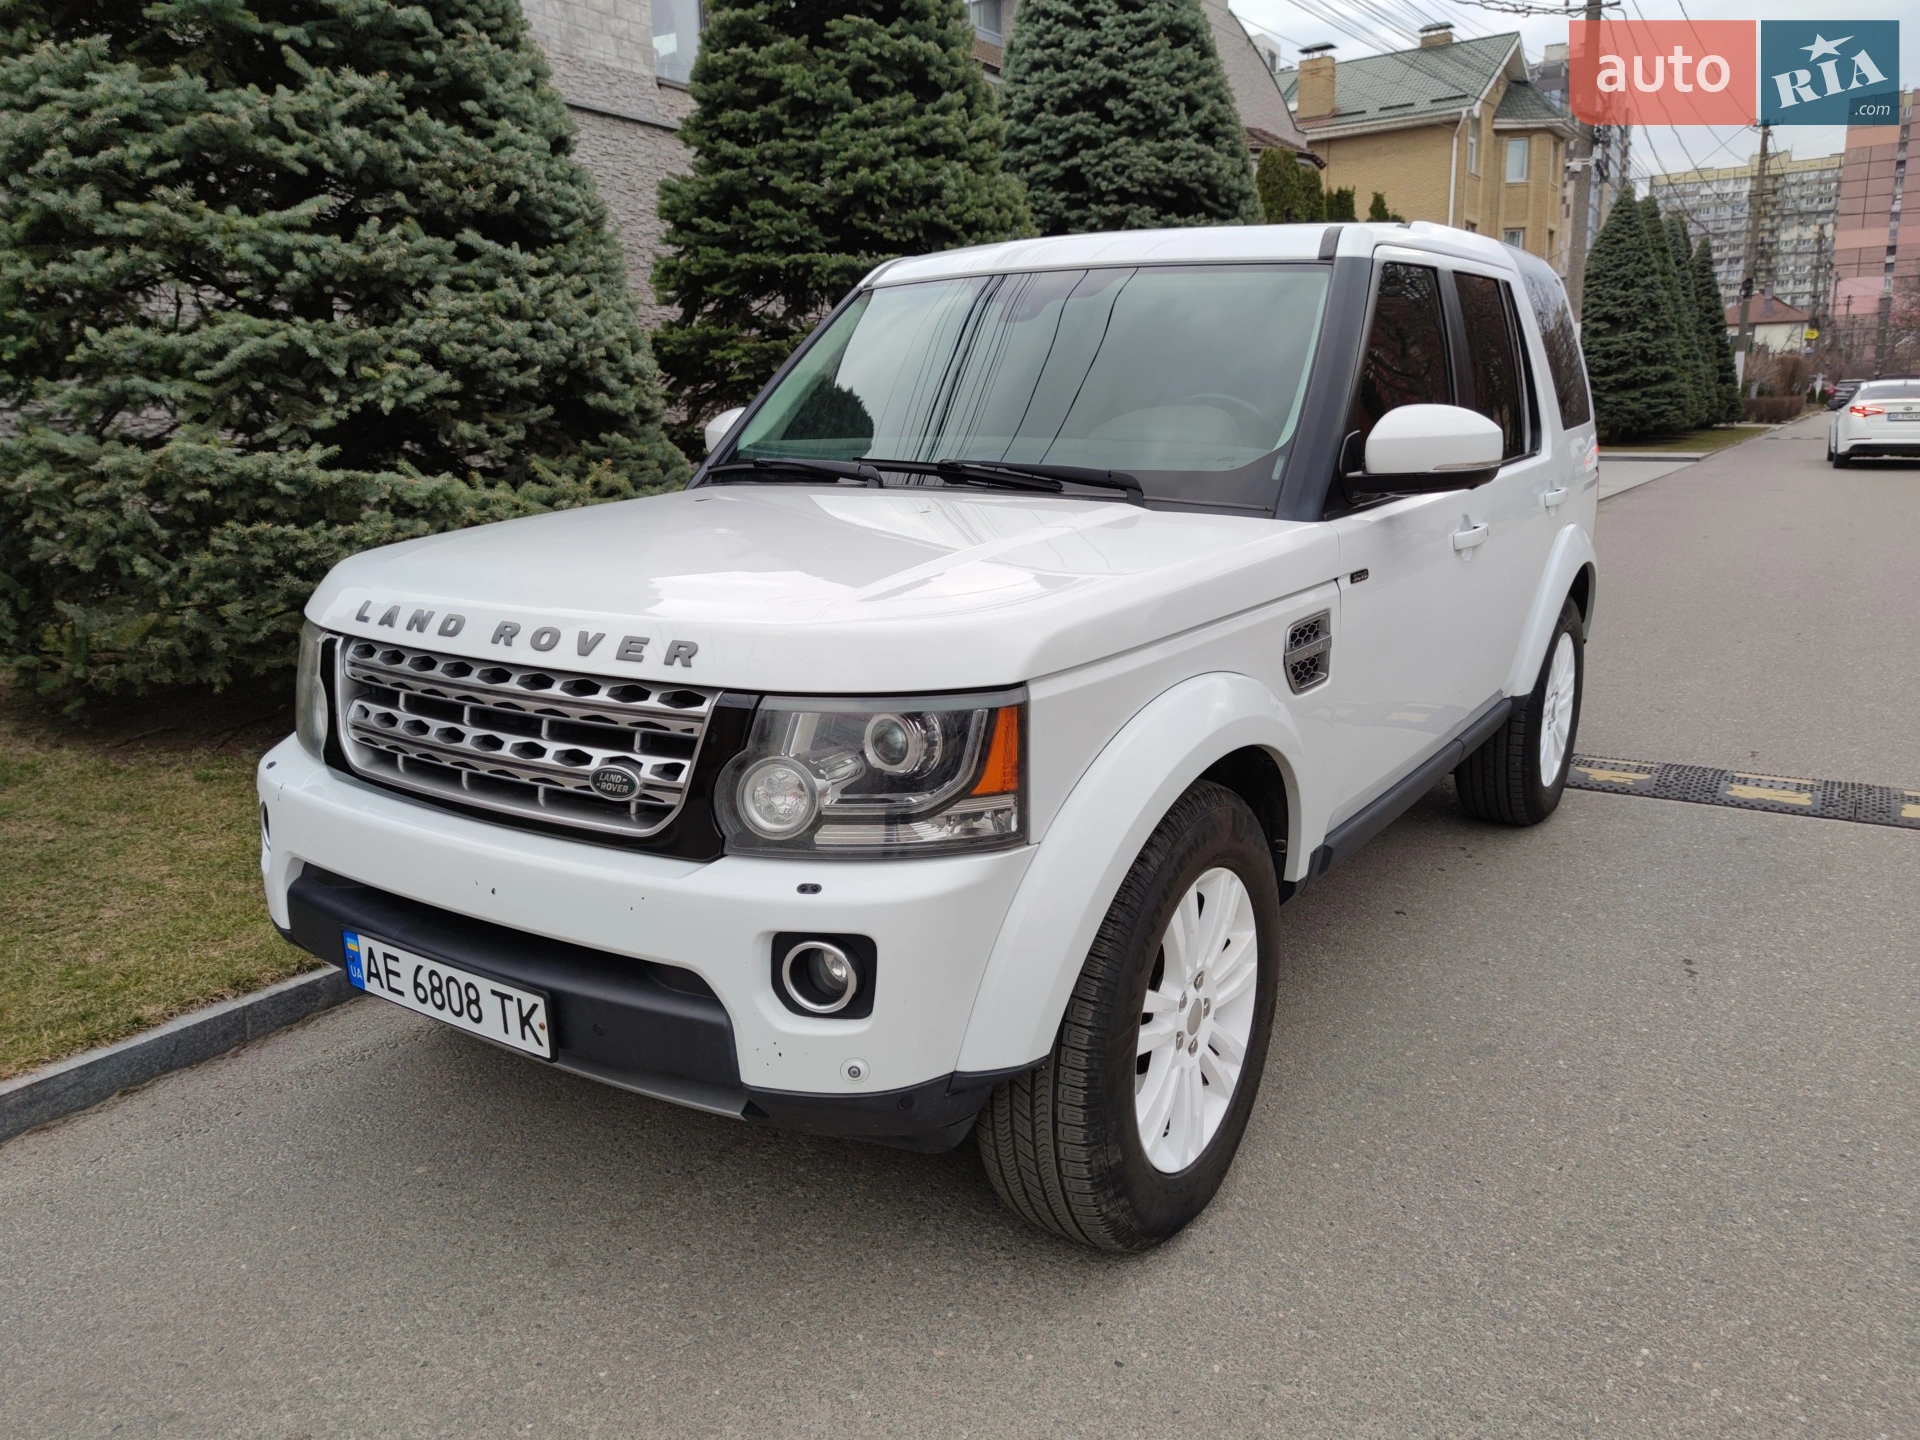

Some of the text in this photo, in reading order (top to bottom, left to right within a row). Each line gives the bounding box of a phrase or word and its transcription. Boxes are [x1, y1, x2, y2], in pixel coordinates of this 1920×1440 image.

[355, 600, 699, 668] LAND ROVER
[349, 964, 364, 980] UA
[366, 946, 544, 1047] AE 6808 TK
